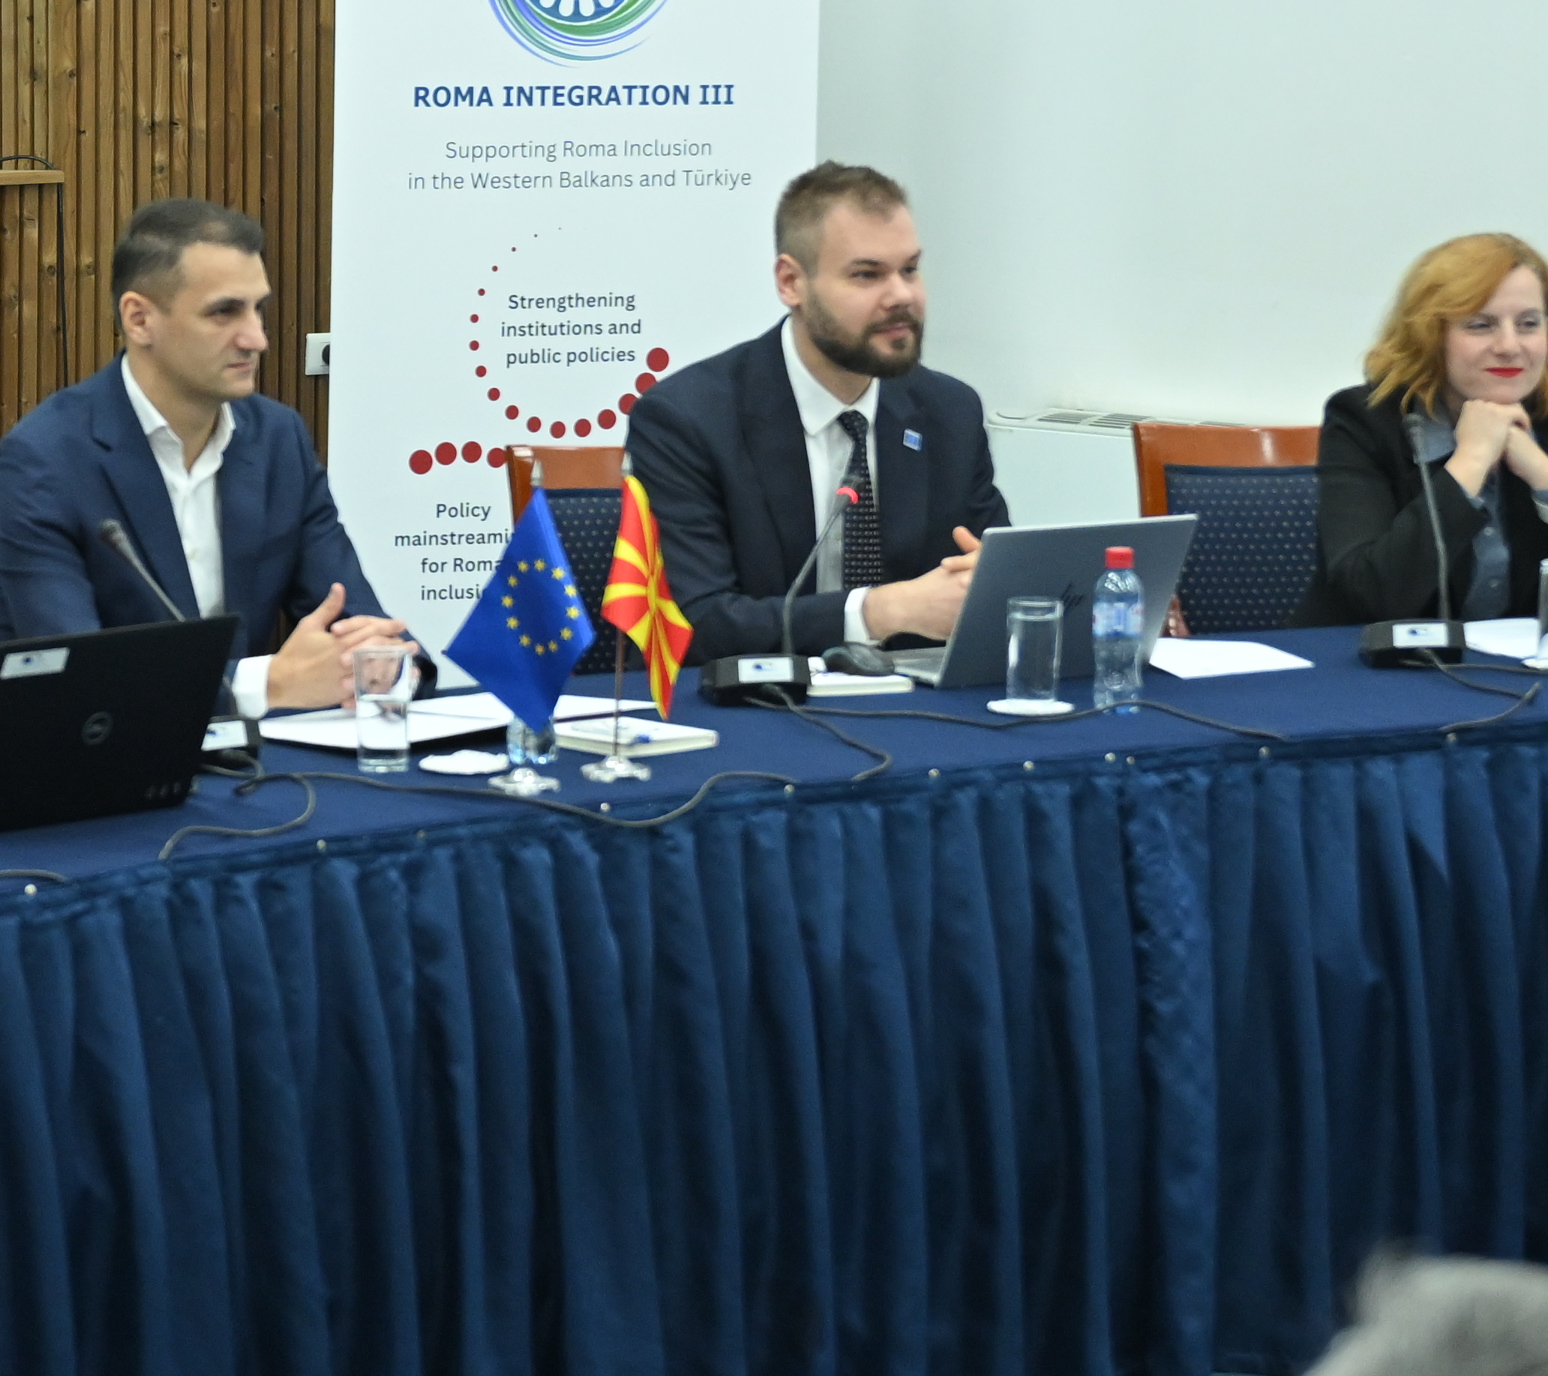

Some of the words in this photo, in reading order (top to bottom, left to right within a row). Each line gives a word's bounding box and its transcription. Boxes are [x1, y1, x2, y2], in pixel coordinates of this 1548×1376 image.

[413, 85, 494, 108] ROMA
[502, 84, 690, 107] INTEGRATION
[698, 84, 735, 105] III
[445, 140, 557, 163] Supporting
[562, 140, 618, 158] Roma
[623, 139, 712, 157] Inclusion
[408, 172, 425, 190] in
[431, 172, 465, 190] the
[470, 172, 553, 189] Western
[559, 170, 633, 189] Balkans
[639, 169, 676, 187] and
[681, 168, 752, 191] Türkiye
[508, 292, 636, 313] Strengthening
[500, 321, 603, 337] institutions
[607, 319, 642, 335] and
[506, 348, 562, 369] public
[566, 346, 636, 367] policies
[436, 502, 492, 521] Policy
[394, 528, 513, 547] mainstreami
[420, 557, 448, 573] for
[420, 584, 484, 601] inclusi
